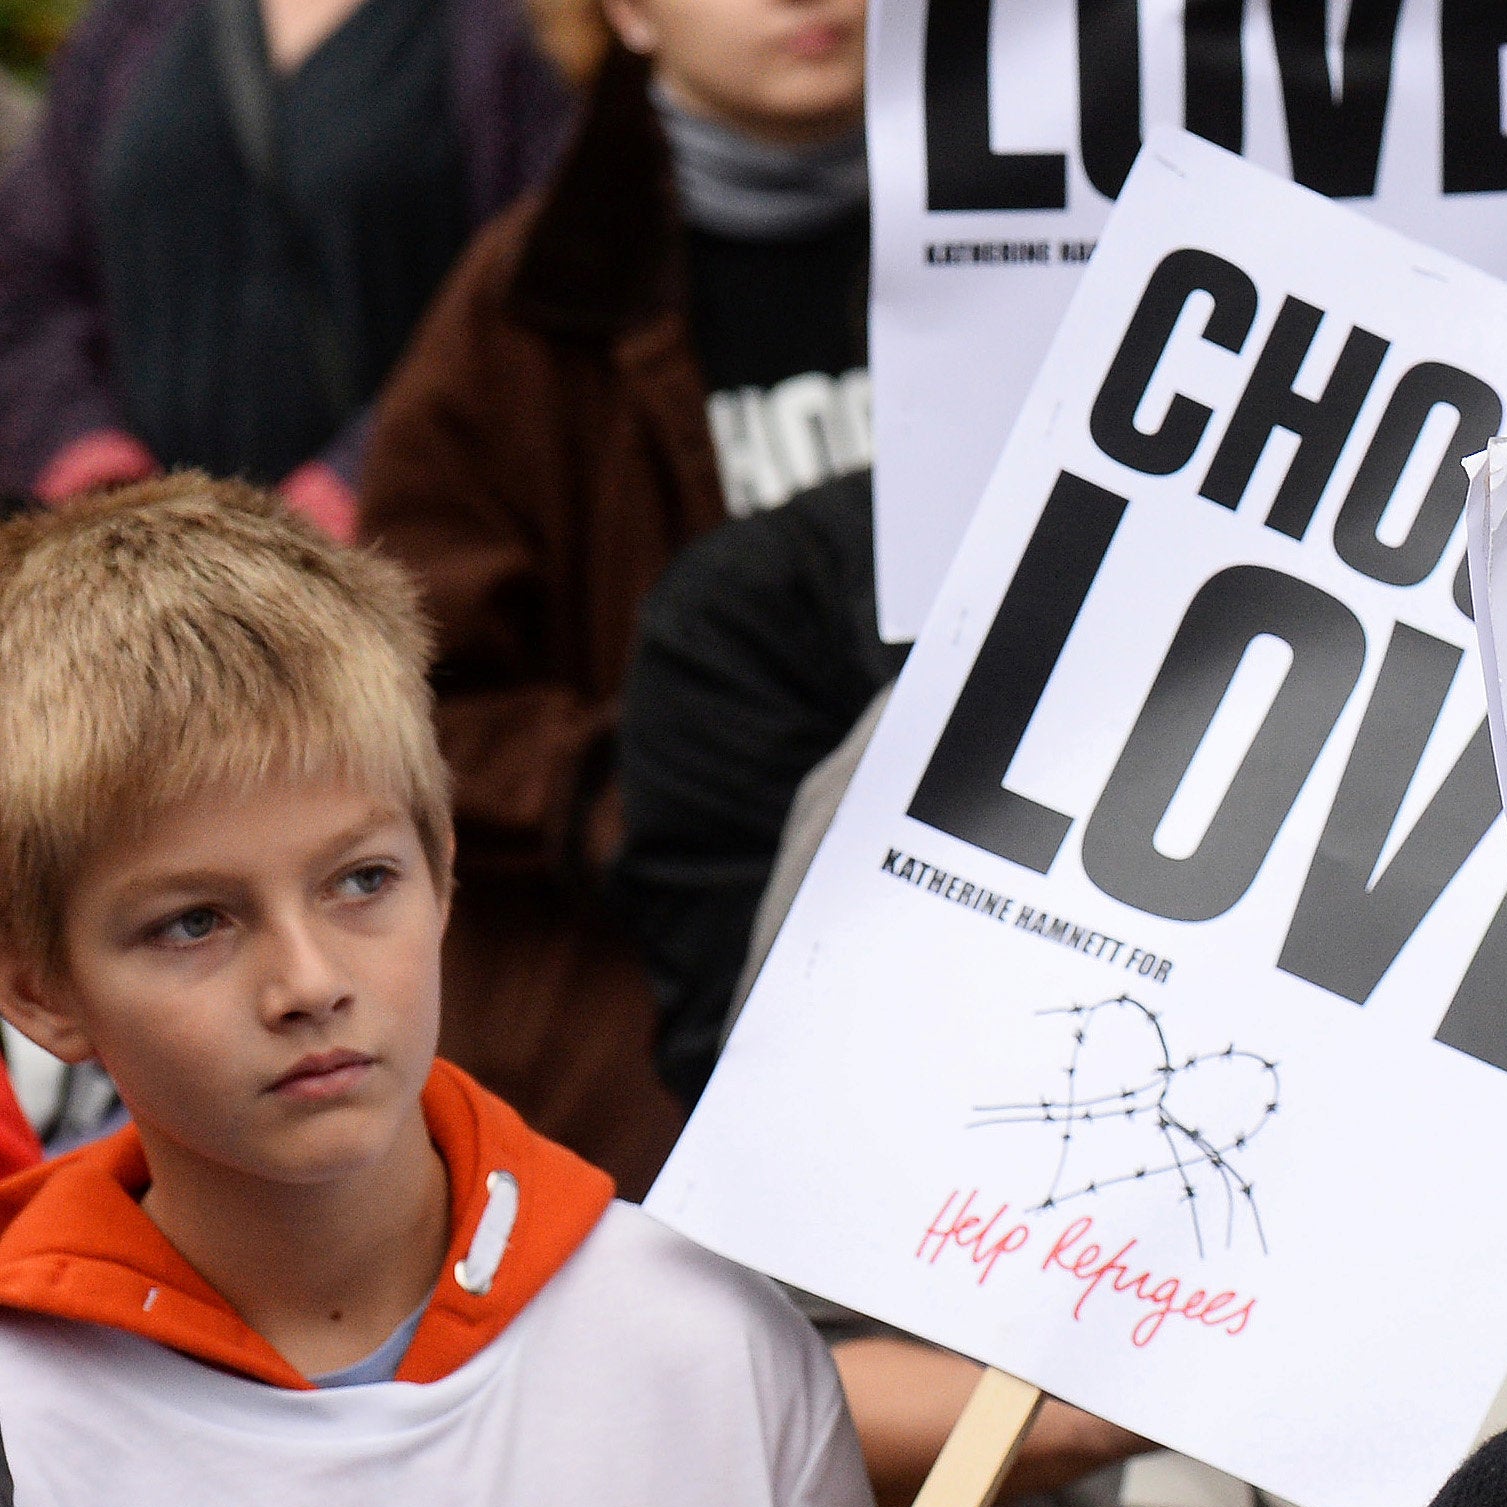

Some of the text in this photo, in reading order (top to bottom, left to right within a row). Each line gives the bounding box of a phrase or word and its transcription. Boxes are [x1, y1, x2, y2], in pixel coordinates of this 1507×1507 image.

[881, 848, 1174, 985] KATHERINE HAMNETT FOR
[916, 1189, 1257, 1348] Help Refugees
